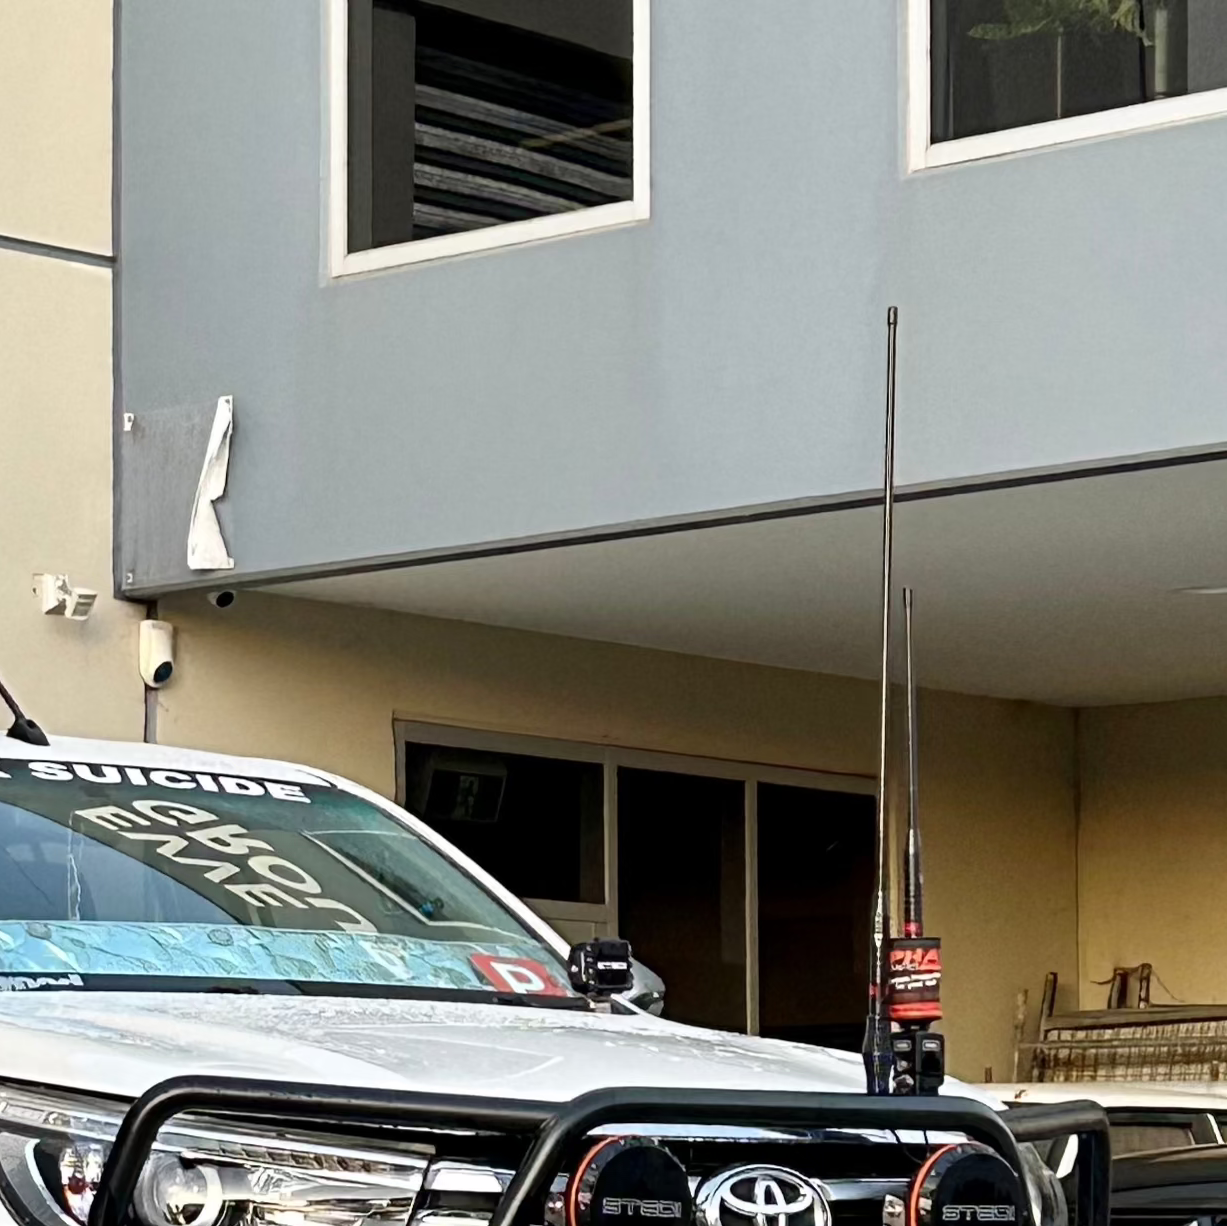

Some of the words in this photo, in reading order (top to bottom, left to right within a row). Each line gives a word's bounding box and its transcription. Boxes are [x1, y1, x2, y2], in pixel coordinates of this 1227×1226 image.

[28, 761, 311, 803] SUICIDE
[602, 1197, 682, 1218] STEDI
[942, 1204, 1016, 1222] STEDI
